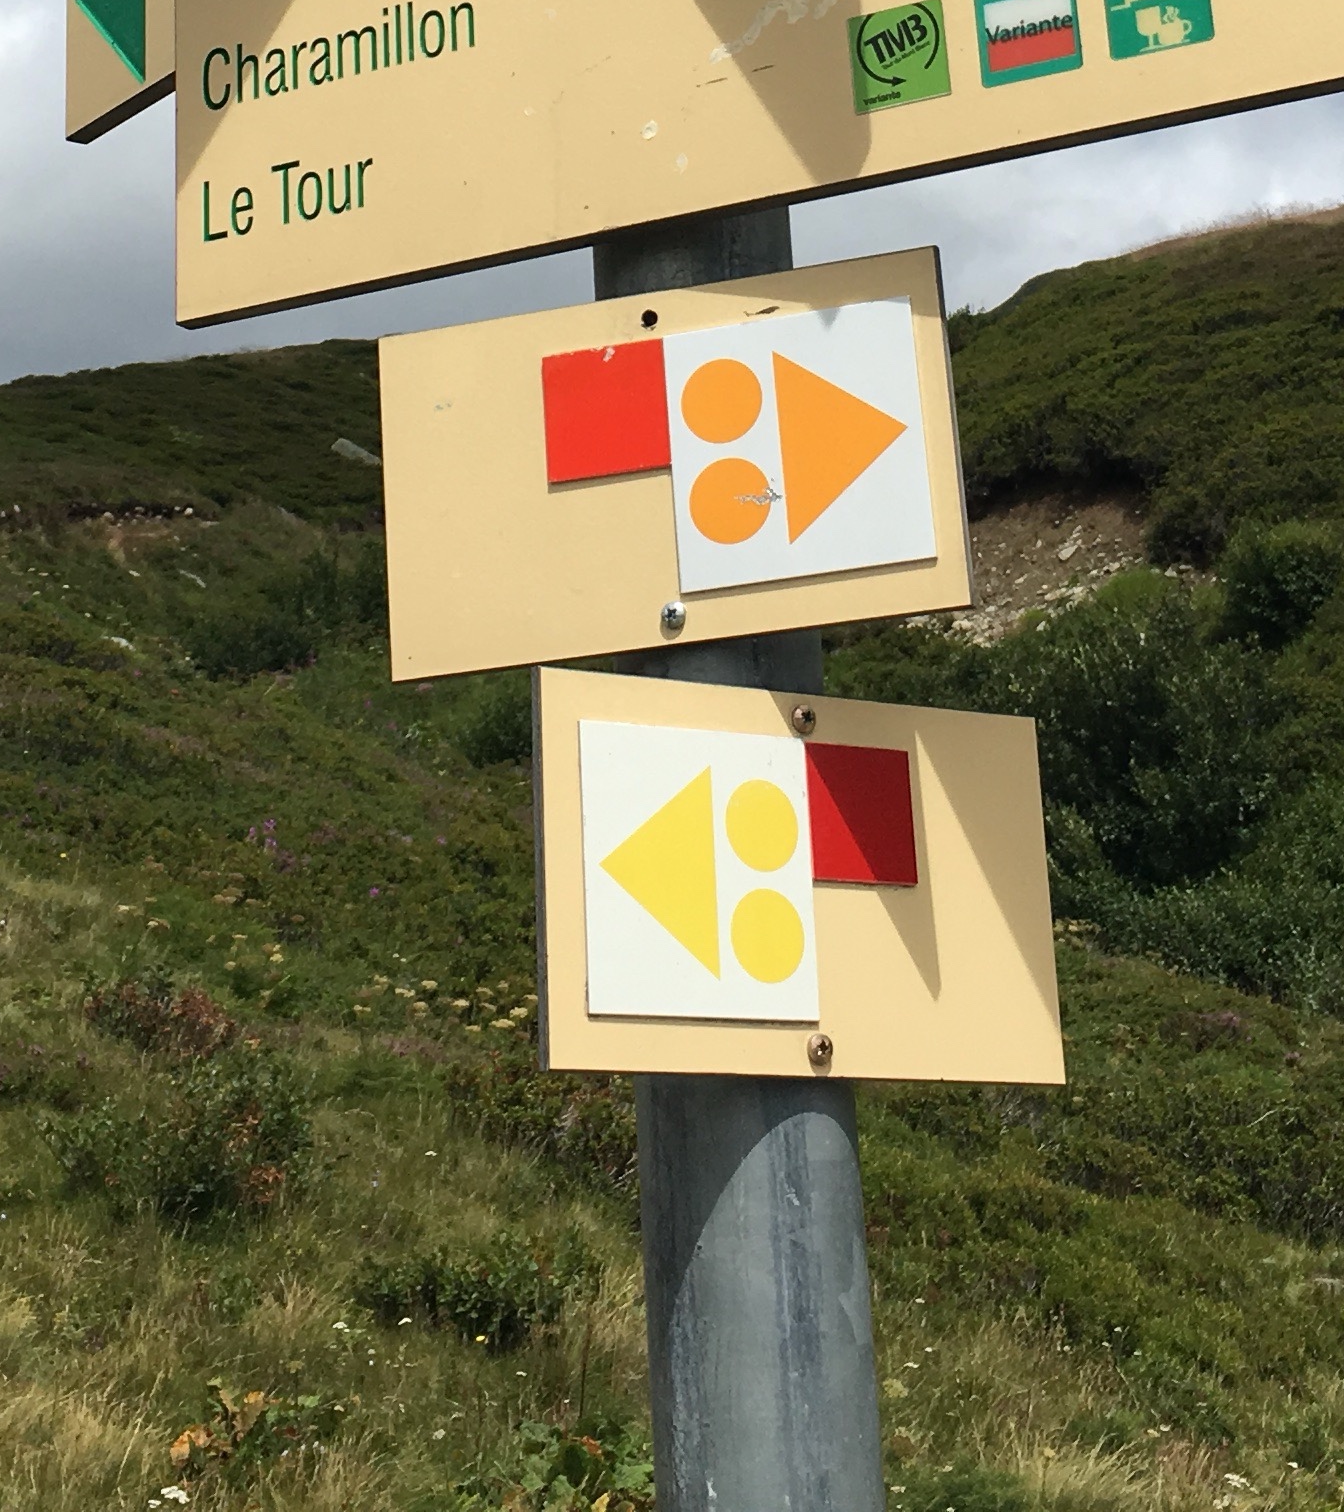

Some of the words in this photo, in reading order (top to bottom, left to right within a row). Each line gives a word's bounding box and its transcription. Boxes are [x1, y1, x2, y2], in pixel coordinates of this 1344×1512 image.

[202, 1, 476, 112] Charamillon
[863, 13, 928, 65] TMB
[984, 14, 1074, 46] Variante
[202, 180, 254, 243] Le
[270, 157, 374, 225] Tour
